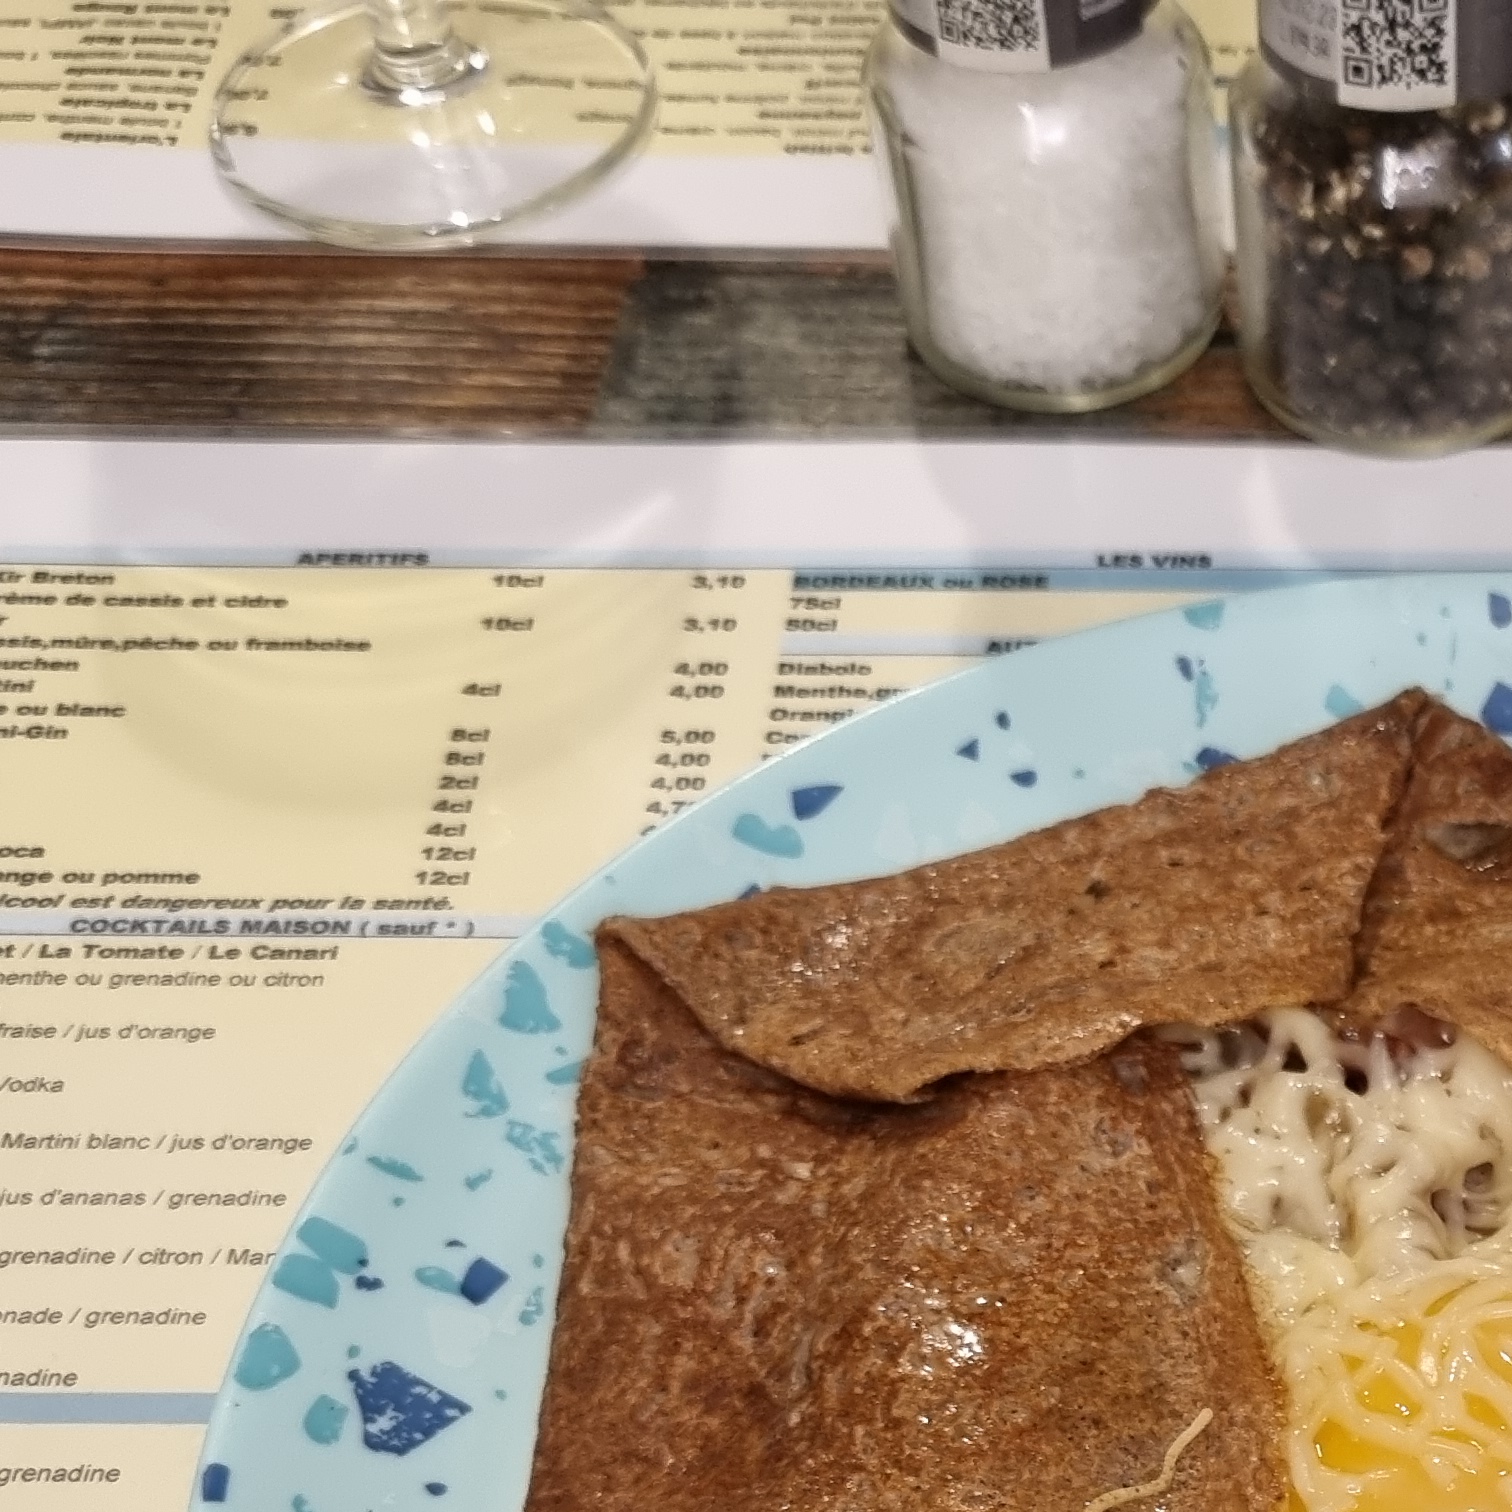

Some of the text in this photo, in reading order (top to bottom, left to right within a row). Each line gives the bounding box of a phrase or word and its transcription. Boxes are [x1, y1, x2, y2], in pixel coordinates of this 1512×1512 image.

[297, 552, 429, 567] APERITIFS
[31, 571, 115, 585] Breton
[493, 574, 544, 588] 10cl
[794, 574, 934, 589] BORDEAUX
[64, 594, 288, 608] de cassis et cidre
[480, 617, 534, 631] 10cl
[205, 638, 371, 652] ou framboise
[673, 662, 728, 677] 4,00
[777, 661, 871, 675] Diabolo
[461, 683, 502, 697] 4cl
[669, 684, 724, 699] 4,00
[15, 703, 126, 717] ou blanc
[451, 728, 490, 742] 8cl
[660, 729, 715, 745] 5,00
[445, 751, 484, 766] 8cl
[655, 753, 710, 768] 4,00
[438, 775, 479, 790] 2cl
[650, 776, 706, 792] 4,00
[431, 799, 473, 813] 4cl
[426, 823, 467, 837] 4cl
[421, 847, 476, 861] 12cl
[62, 872, 200, 886] ou pomme
[415, 871, 470, 886] 12cl
[69, 895, 454, 913] est dangereux pour la santé.
[67, 918, 438, 938] COCKTAILS MAISON sauf
[38, 944, 338, 960] La Tomate Le Canari
[75, 972, 324, 989] ou grenadine ou citron
[72, 1024, 216, 1043] jus d'orange
[1, 1133, 312, 1154] Martini blanc jus d'orange
[40, 1189, 287, 1210] d'ananas grenadine
[0, 1248, 203, 1268] grenadine citron
[84, 1308, 206, 1328] grenadine
[0, 1464, 120, 1486] grenadine
